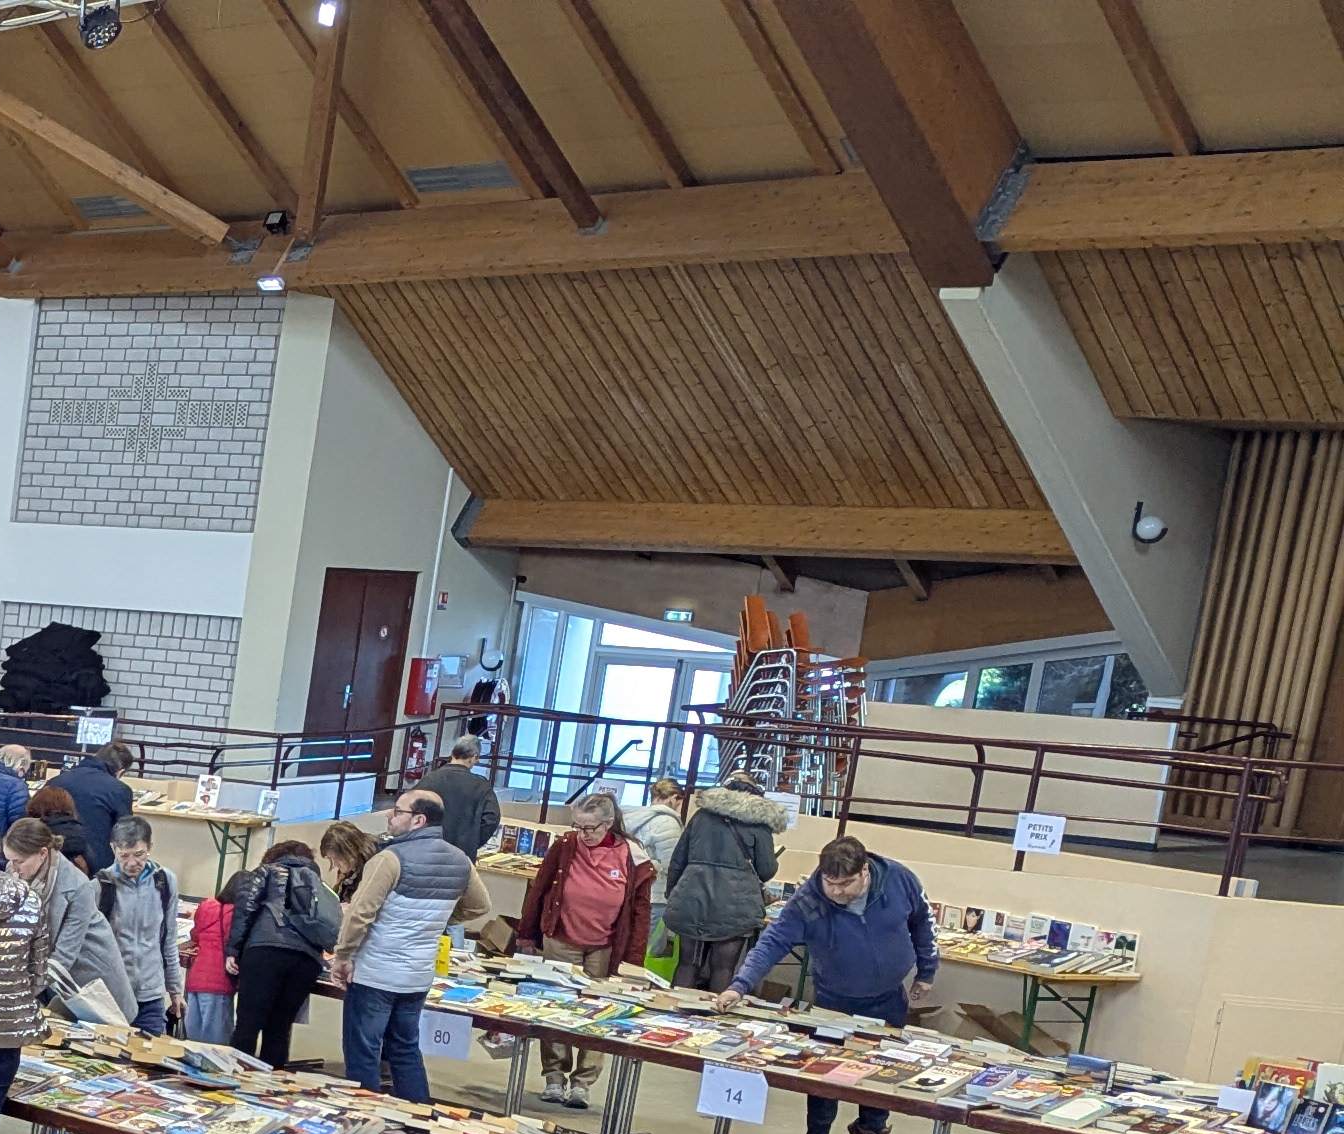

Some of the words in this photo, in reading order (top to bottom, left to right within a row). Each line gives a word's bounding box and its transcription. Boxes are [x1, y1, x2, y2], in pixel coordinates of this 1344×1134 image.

[1027, 823, 1054, 833] PETITS
[1029, 832, 1049, 841] PRIX
[434, 1029, 451, 1045] 80
[724, 1087, 743, 1104] 14
